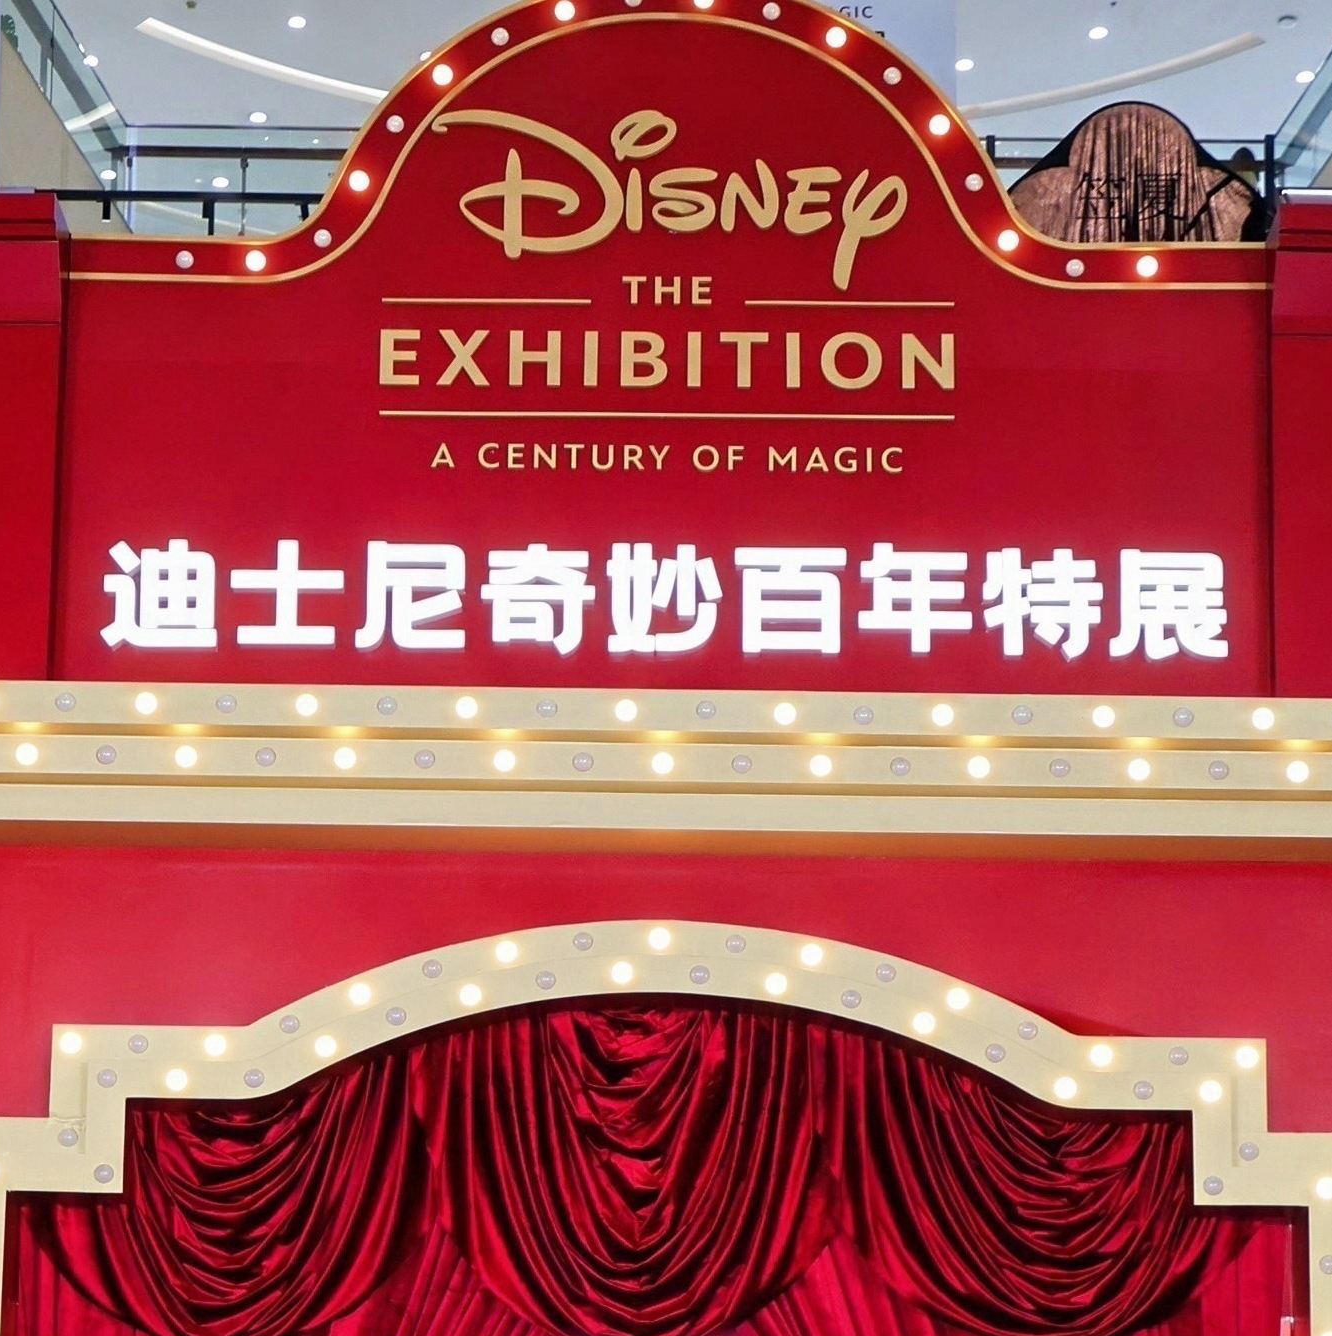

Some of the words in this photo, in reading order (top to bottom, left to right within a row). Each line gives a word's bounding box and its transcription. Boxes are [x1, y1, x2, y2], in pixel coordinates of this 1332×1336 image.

[622, 276, 713, 305] THE
[379, 329, 956, 391] EXHIBITION
[430, 442, 456, 468] A
[478, 442, 671, 470] CENTURY
[692, 444, 746, 471] OF
[768, 446, 904, 473] MAGIC
[99, 538, 1230, 662] 迪士尼奇妙百年特展
